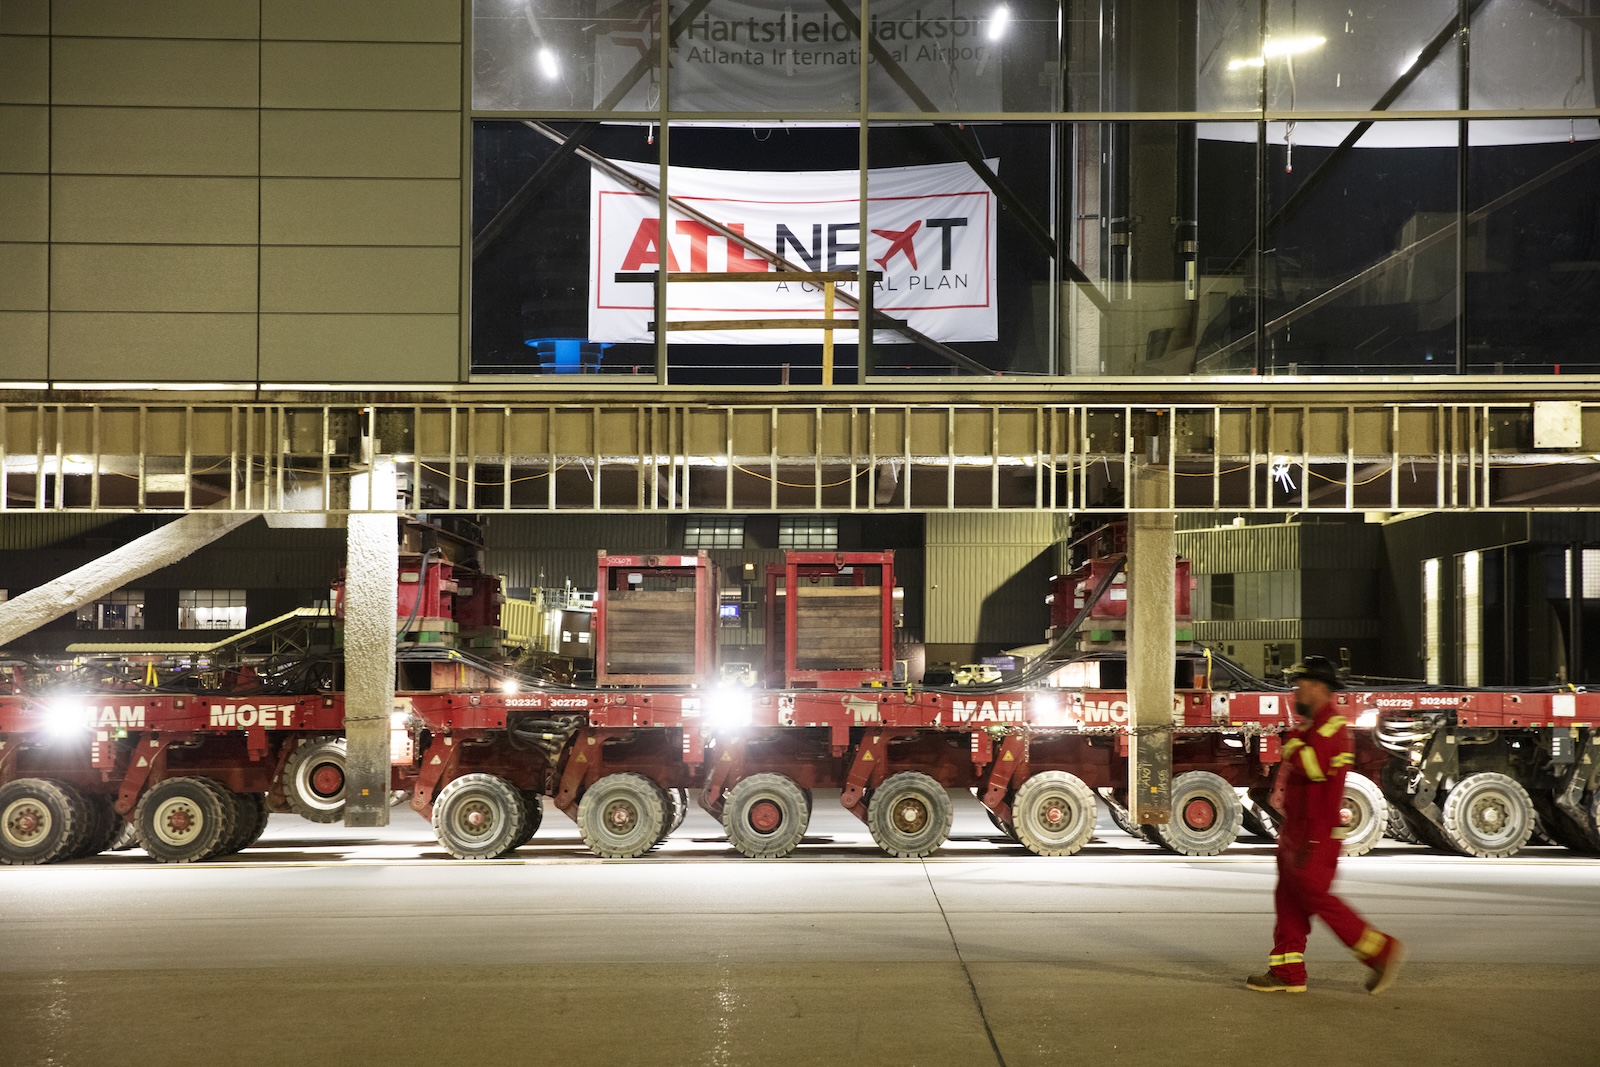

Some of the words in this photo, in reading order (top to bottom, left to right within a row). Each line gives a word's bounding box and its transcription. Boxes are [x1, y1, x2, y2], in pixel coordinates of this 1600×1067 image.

[687, 46, 764, 65] Atlanta
[773, 45, 908, 65] Internatioal
[915, 44, 986, 66] Airpor
[776, 279, 790, 292] A
[801, 277, 898, 292] CPIAL
[909, 274, 967, 290] PLAN
[505, 698, 541, 707] 302321
[550, 698, 588, 707] 302729
[952, 700, 1023, 722] MAM
[1084, 700, 1129, 723] MO
[210, 704, 295, 727] MOET
